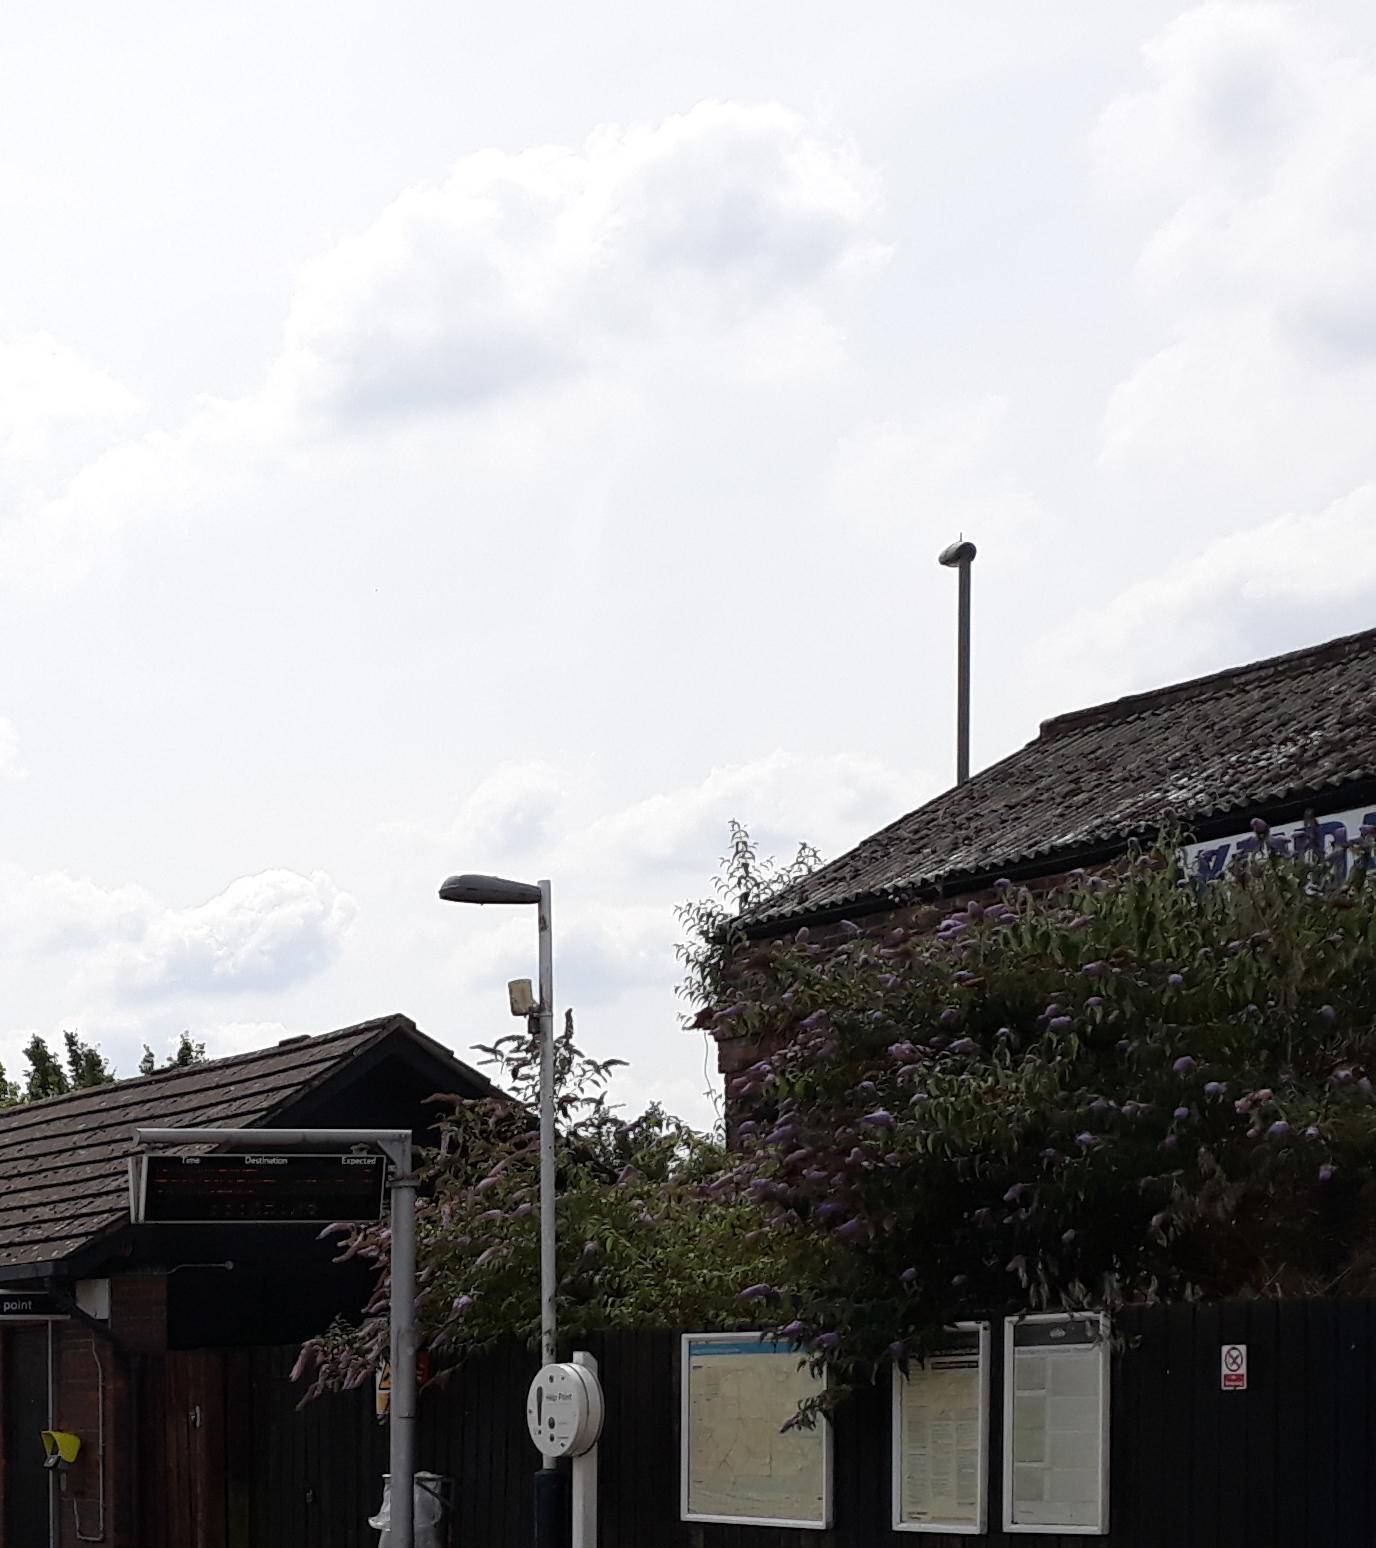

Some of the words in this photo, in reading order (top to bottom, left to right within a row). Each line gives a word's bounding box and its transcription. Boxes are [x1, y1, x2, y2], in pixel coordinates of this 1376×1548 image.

[244, 1156, 289, 1166] Destination
[341, 1156, 376, 1166] Expected
[3, 1300, 33, 1312] point
